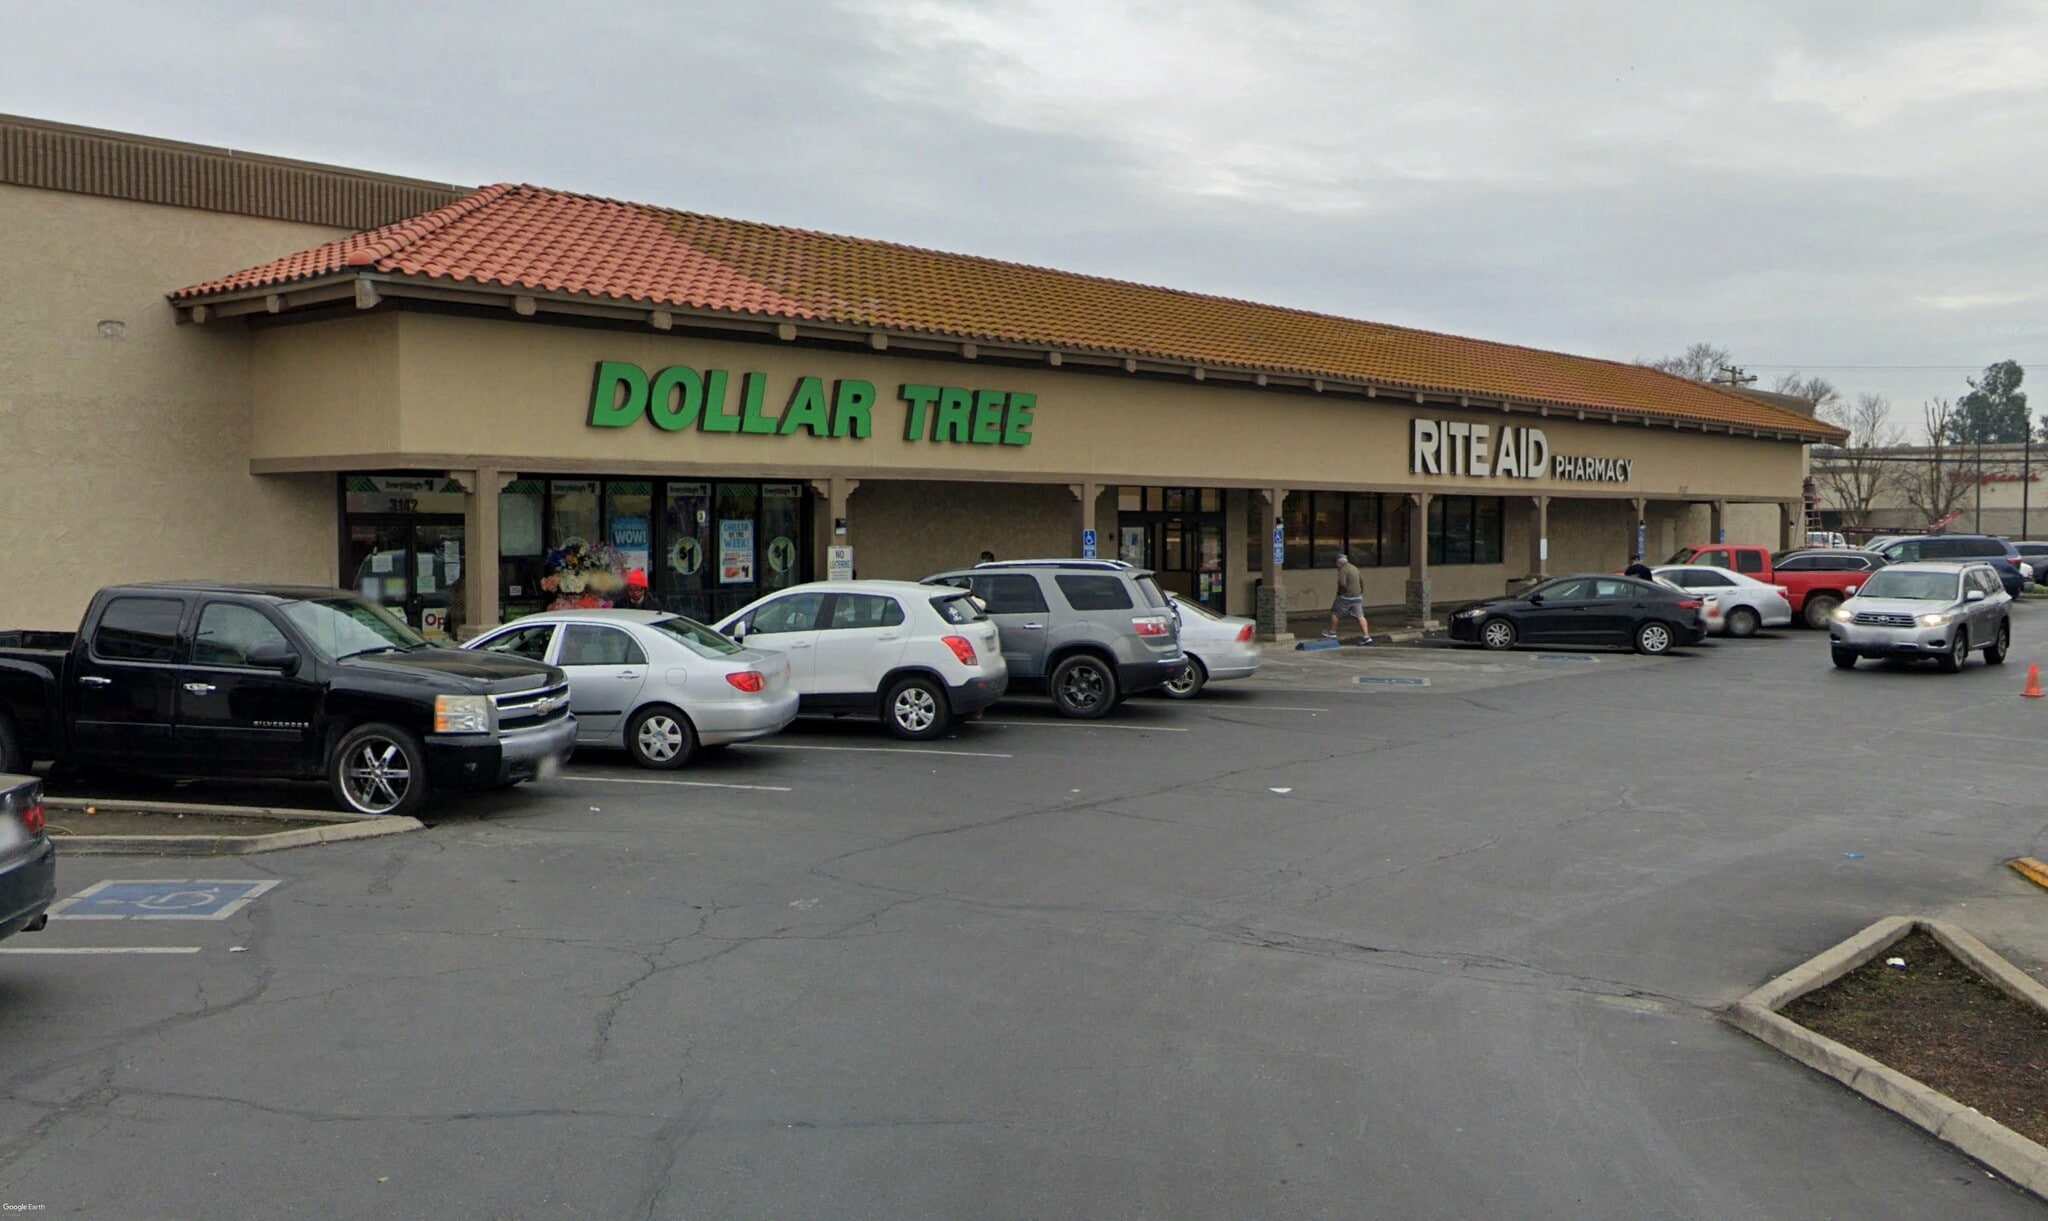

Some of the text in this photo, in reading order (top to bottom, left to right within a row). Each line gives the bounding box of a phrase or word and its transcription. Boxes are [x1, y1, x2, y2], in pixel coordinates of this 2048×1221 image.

[586, 360, 1038, 446] DOLLAR TREE
[1410, 417, 1635, 483] RITE AID PHARMACY
[614, 530, 647, 545] WOW!
[835, 550, 845, 559] NO
